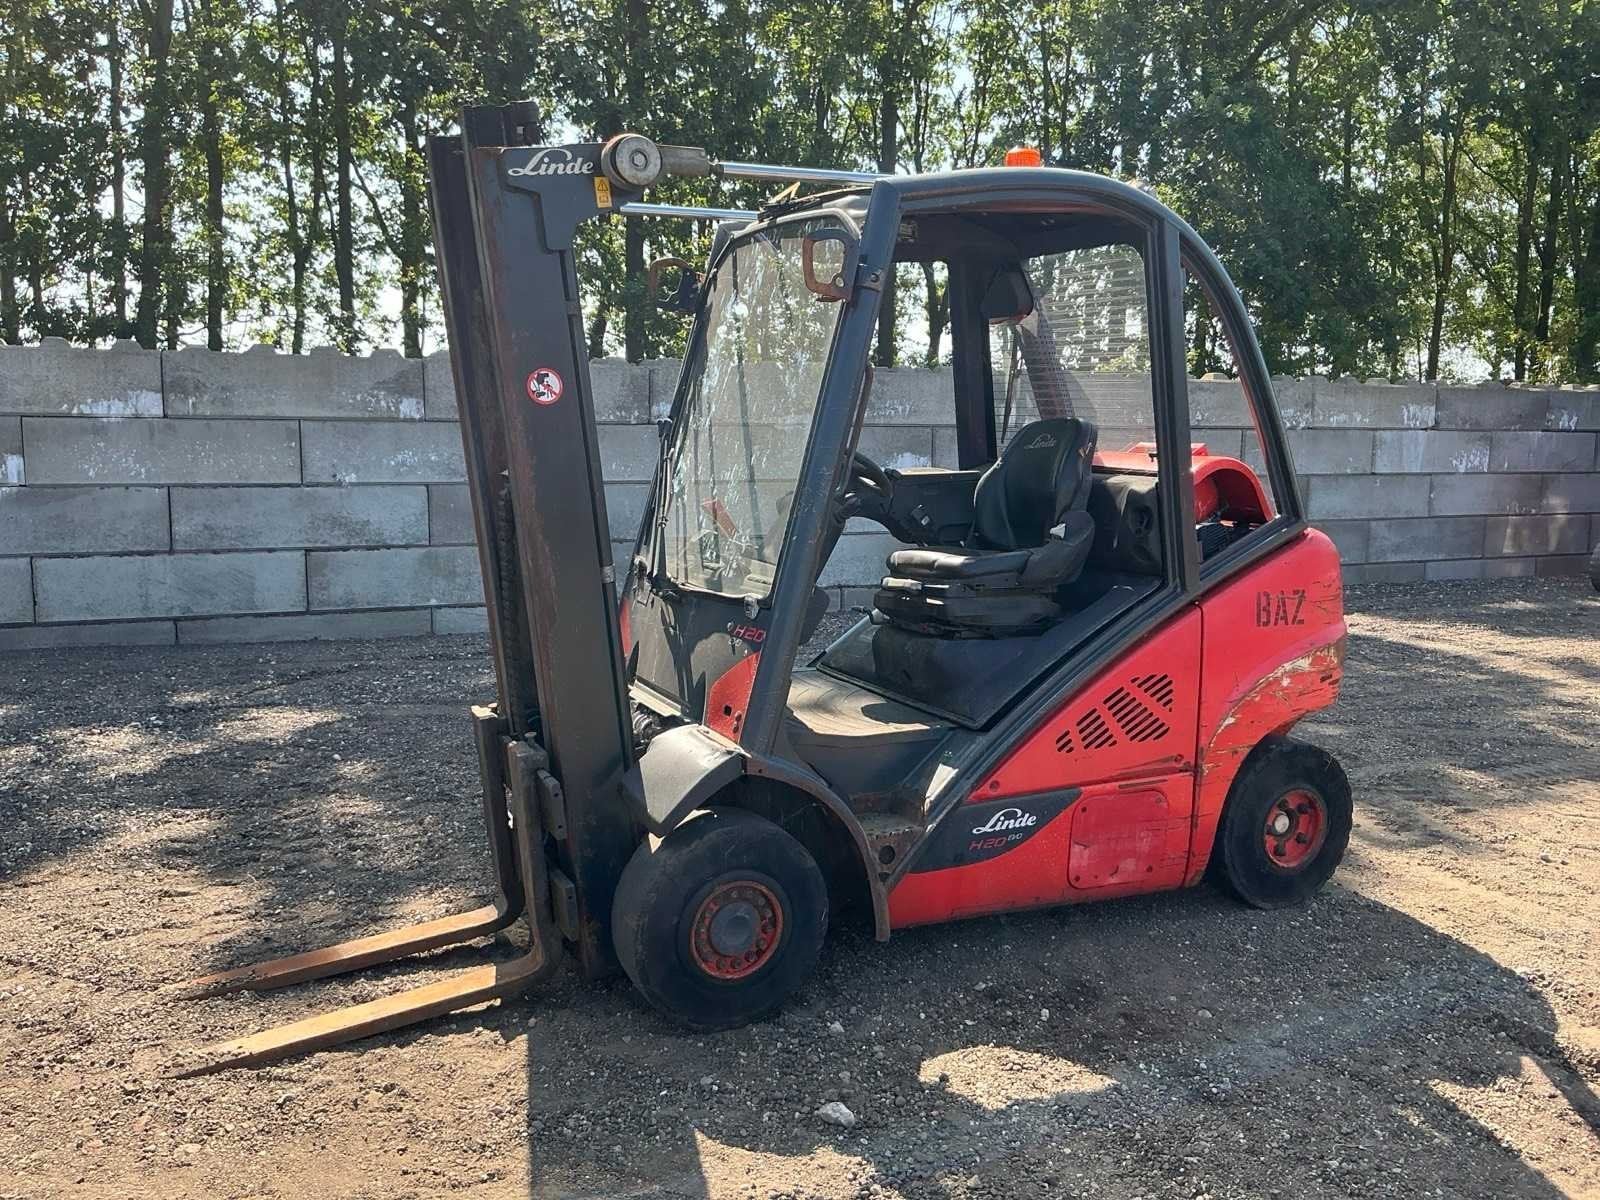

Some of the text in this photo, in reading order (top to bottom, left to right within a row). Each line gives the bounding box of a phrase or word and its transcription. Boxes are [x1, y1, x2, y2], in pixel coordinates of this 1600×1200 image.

[508, 149, 594, 176] Linde
[1023, 433, 1057, 450] Linde
[1256, 589, 1306, 627] BAZ
[733, 624, 767, 643] H20
[972, 808, 1037, 835] Linde
[968, 837, 1007, 850] H20
